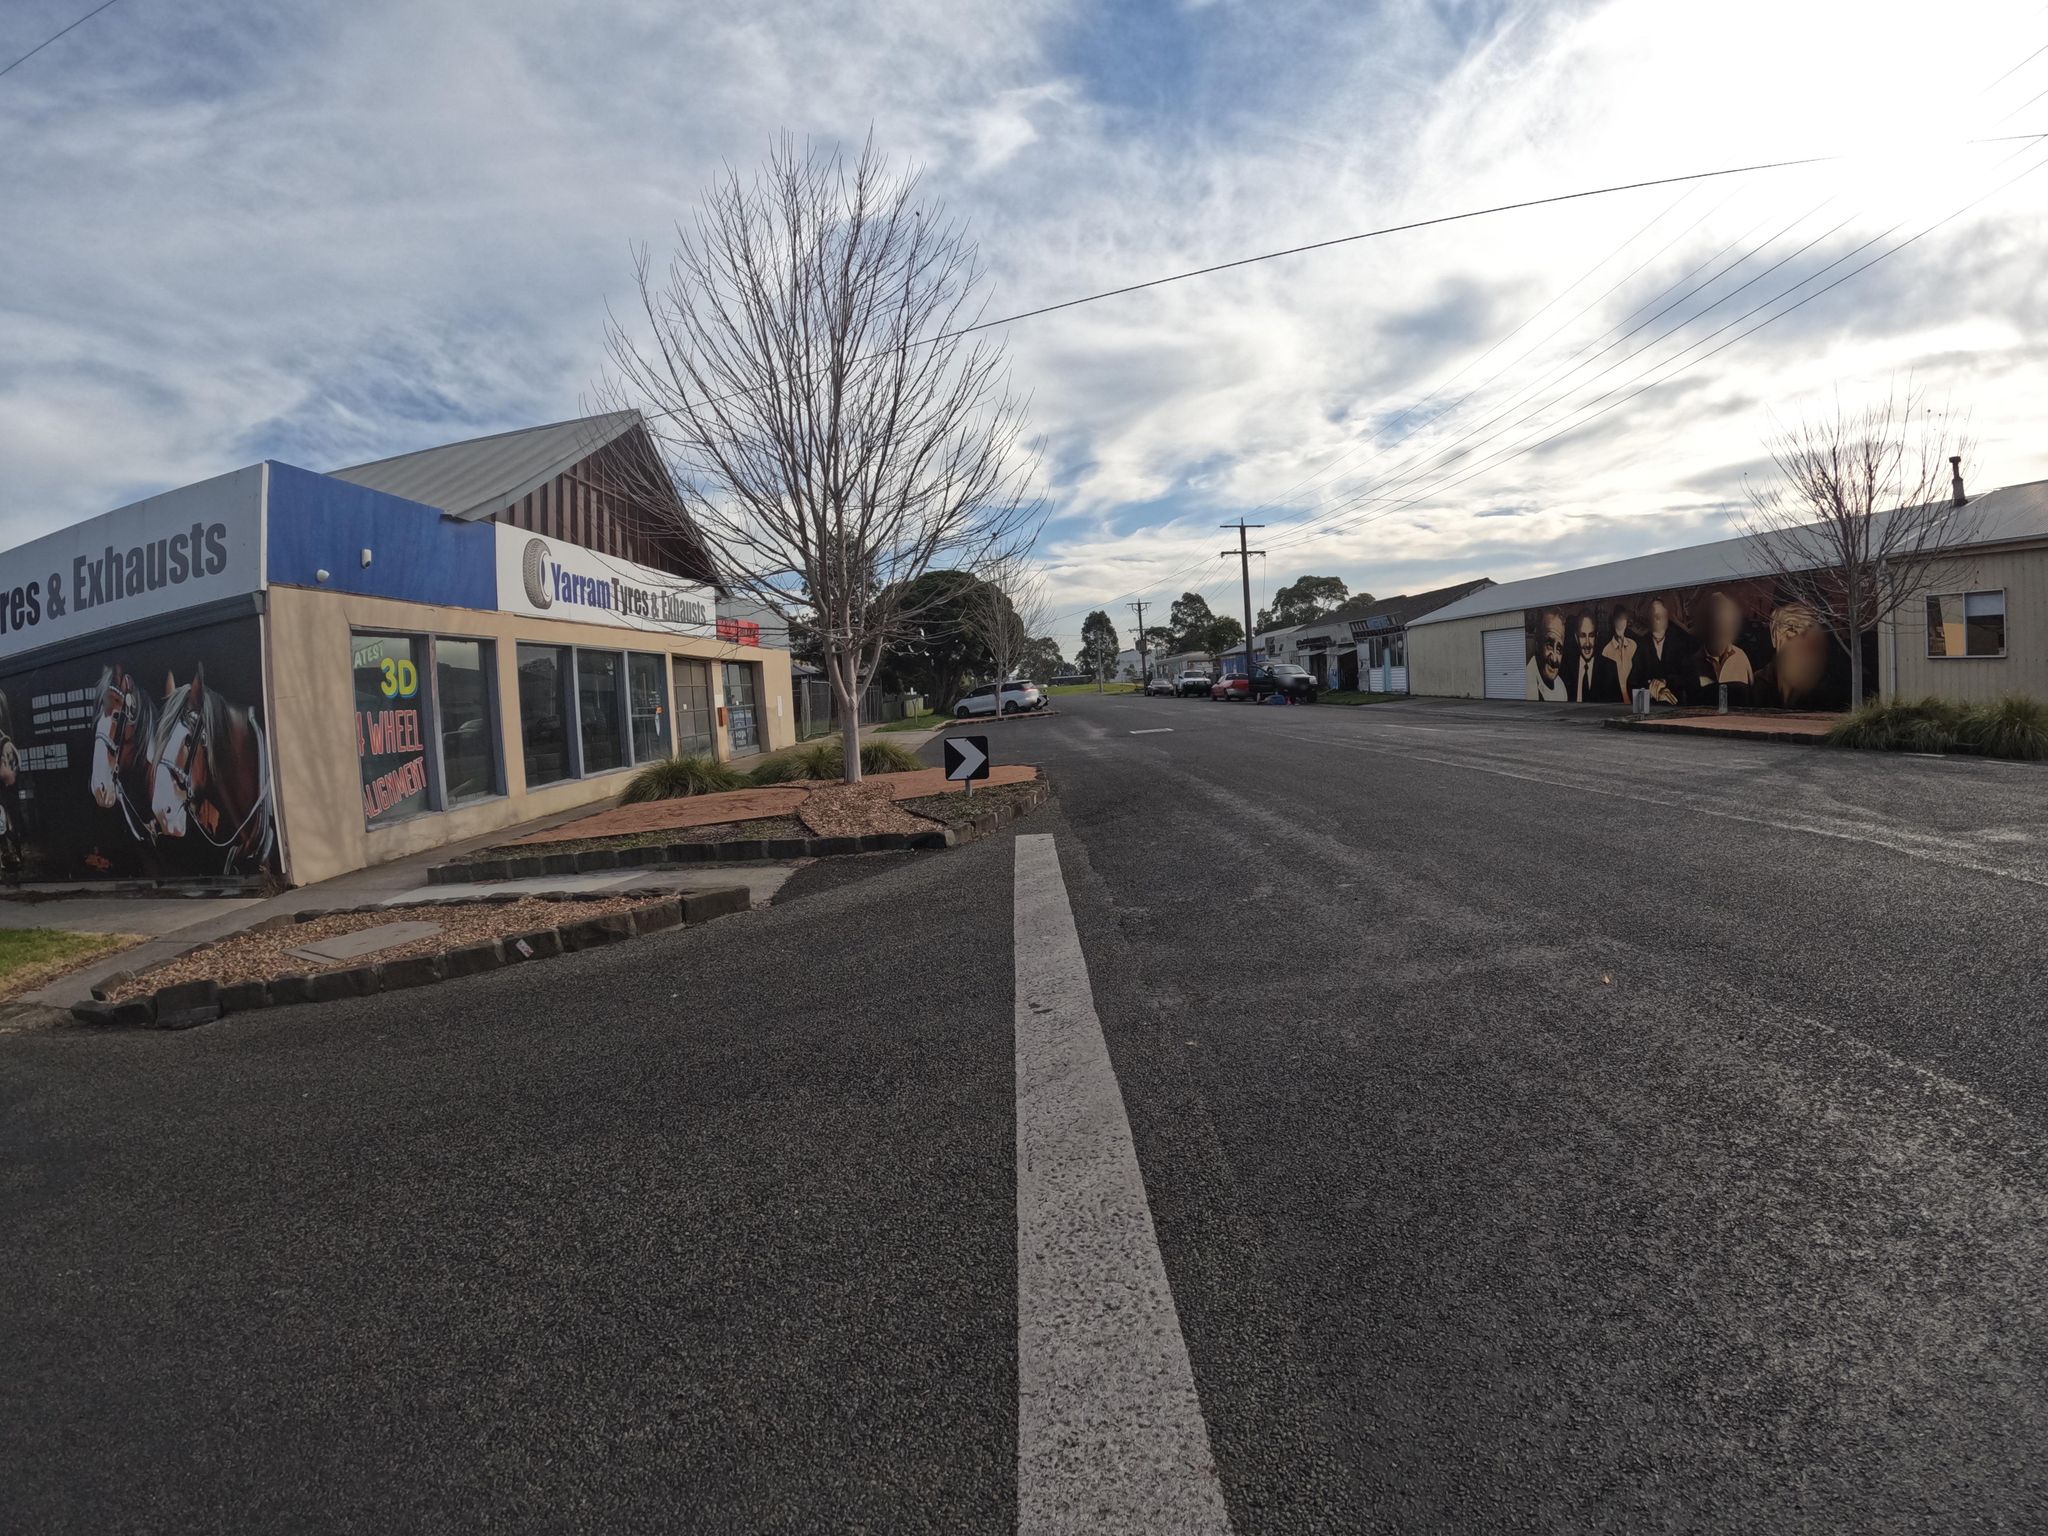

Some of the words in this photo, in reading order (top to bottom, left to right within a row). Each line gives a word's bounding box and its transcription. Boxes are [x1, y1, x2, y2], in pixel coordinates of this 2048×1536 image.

[47, 573, 66, 620] &
[73, 522, 227, 612] Exhausts
[651, 592, 660, 618] &
[662, 590, 706, 624] Exhausts
[380, 658, 418, 698] 3D
[367, 710, 424, 755] WHEEL
